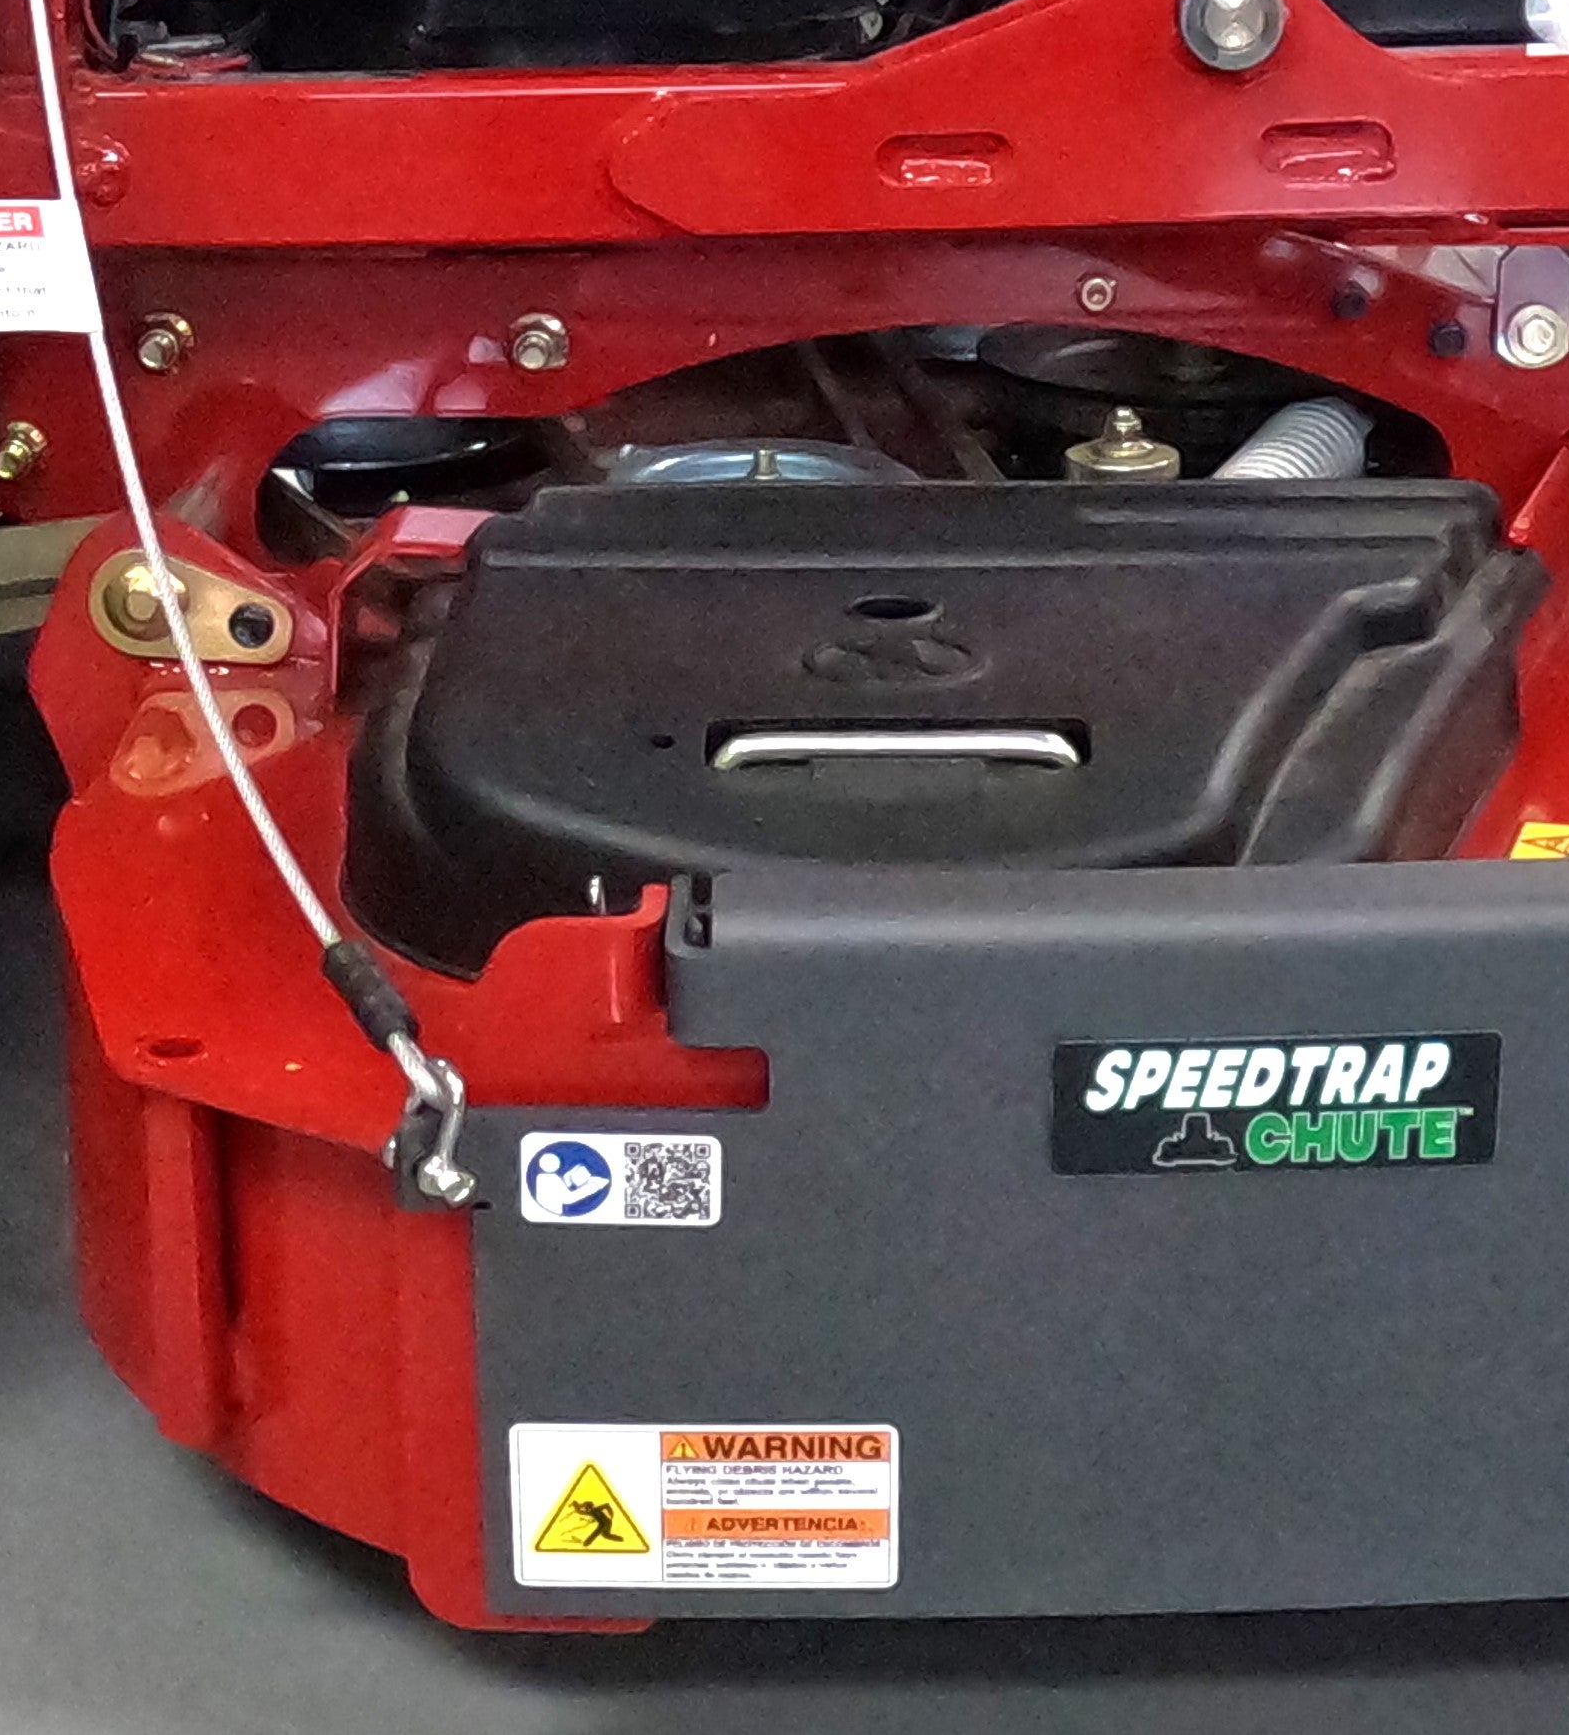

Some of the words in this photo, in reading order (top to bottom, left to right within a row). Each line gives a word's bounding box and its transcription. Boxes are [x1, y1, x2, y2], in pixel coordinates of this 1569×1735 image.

[1084, 1041, 1451, 1112] SPEEDTRAP
[1244, 1106, 1457, 1164] CHUTE
[702, 1434, 883, 1460] WARNING
[665, 1464, 718, 1476] FLYING
[723, 1464, 777, 1476] DEBRIS
[782, 1464, 844, 1476] HAZARD
[705, 1516, 859, 1532] ADVERTENCIA
